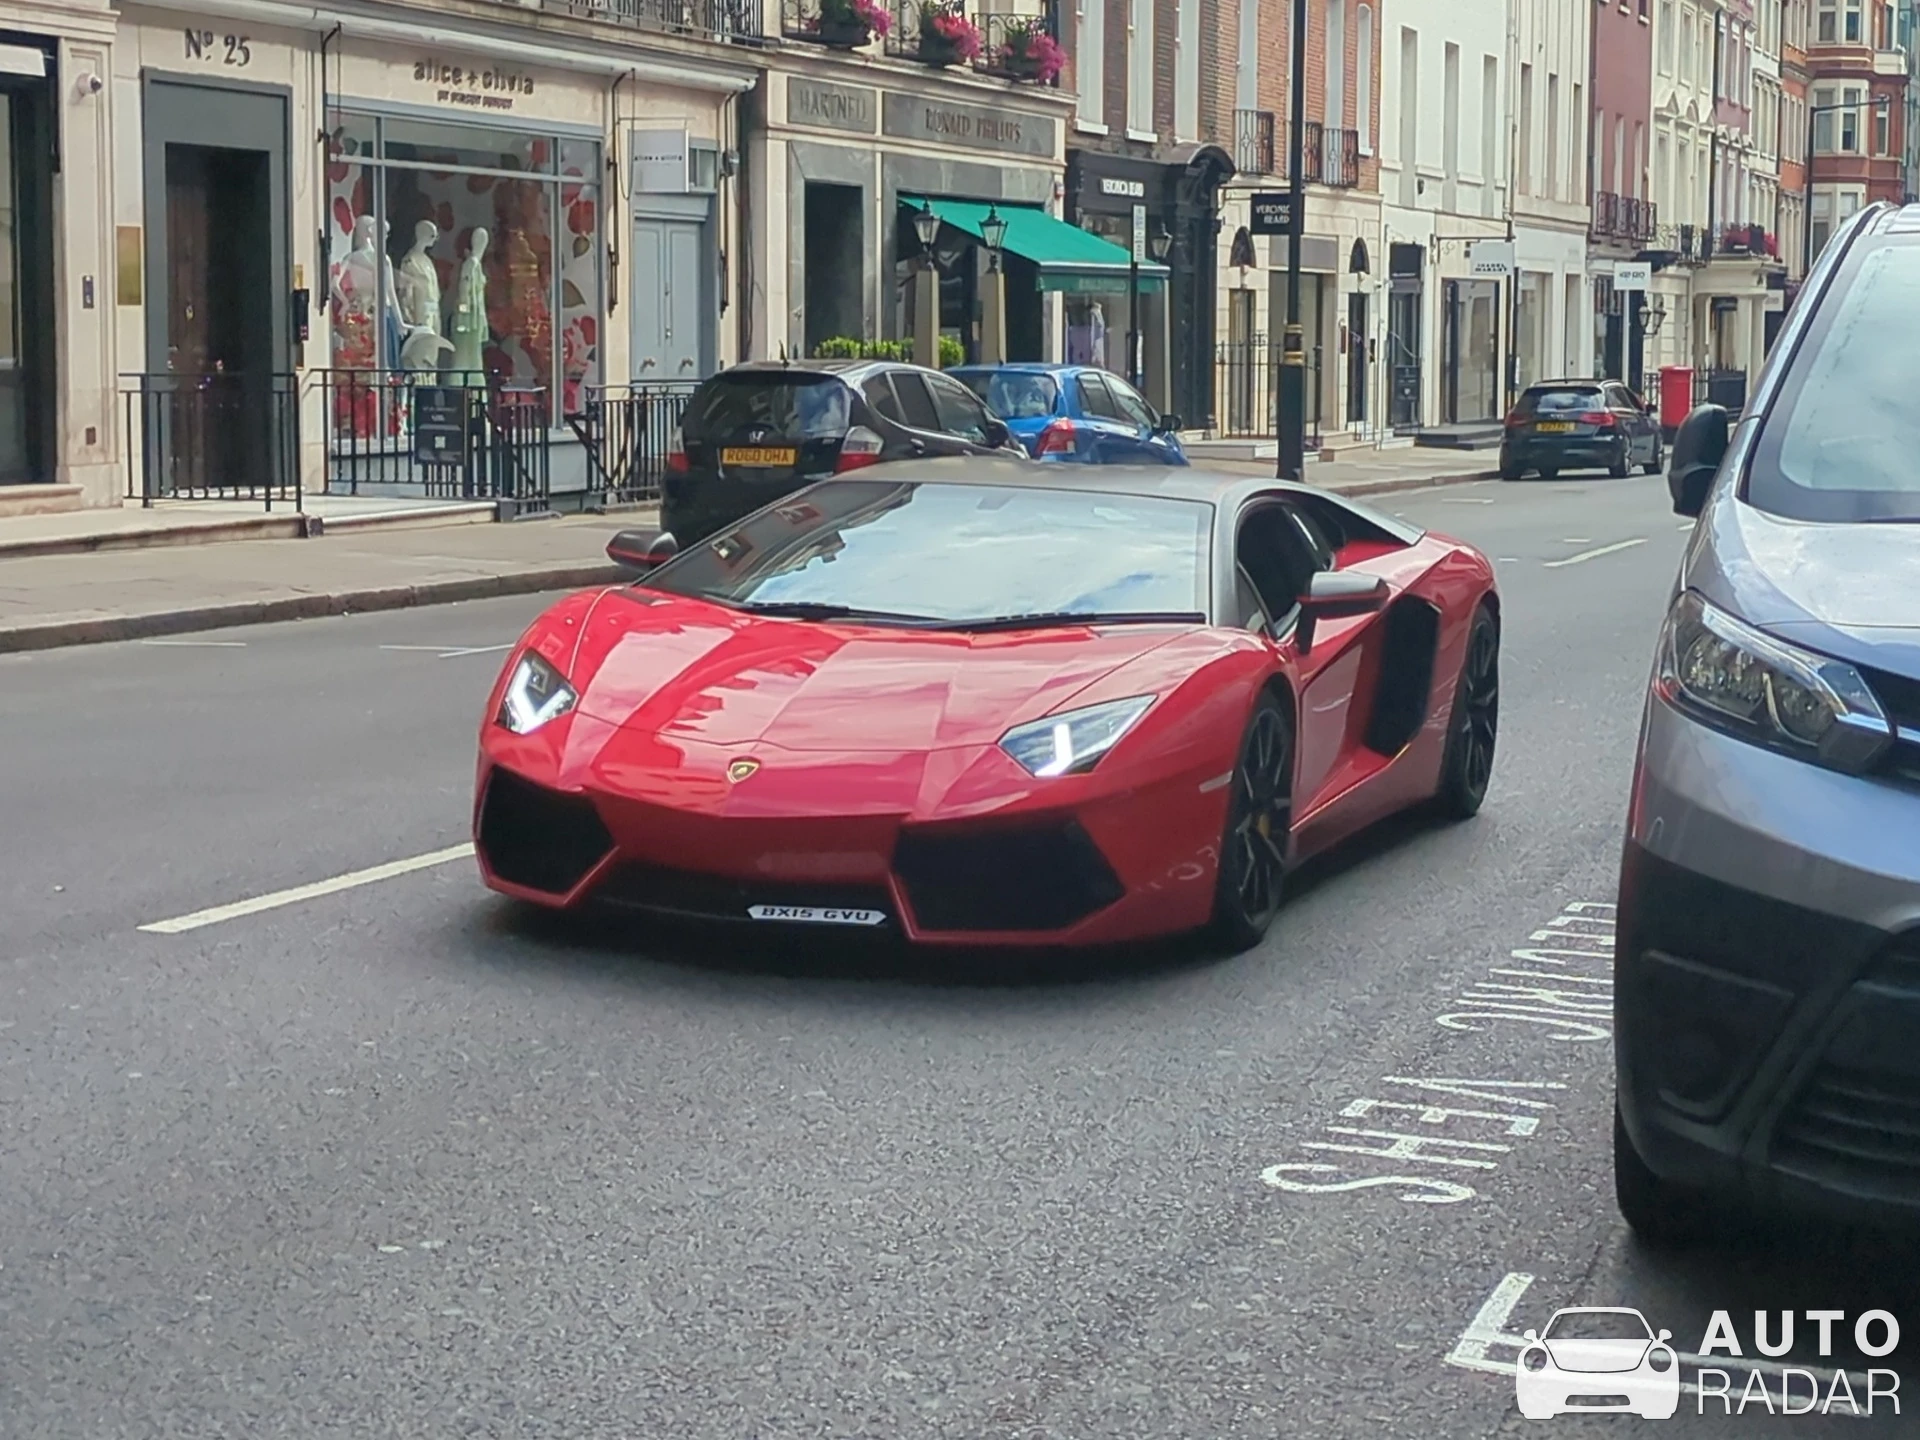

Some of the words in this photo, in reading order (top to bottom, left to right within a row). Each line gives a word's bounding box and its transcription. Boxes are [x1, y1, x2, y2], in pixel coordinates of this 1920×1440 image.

[223, 34, 250, 67] 25
[413, 57, 462, 86] alice
[467, 70, 479, 87] +
[482, 64, 534, 95] olivia
[1255, 203, 1291, 214] VERONIC
[823, 910, 870, 921] GVU
[1259, 1075, 1567, 1203] VEHS
